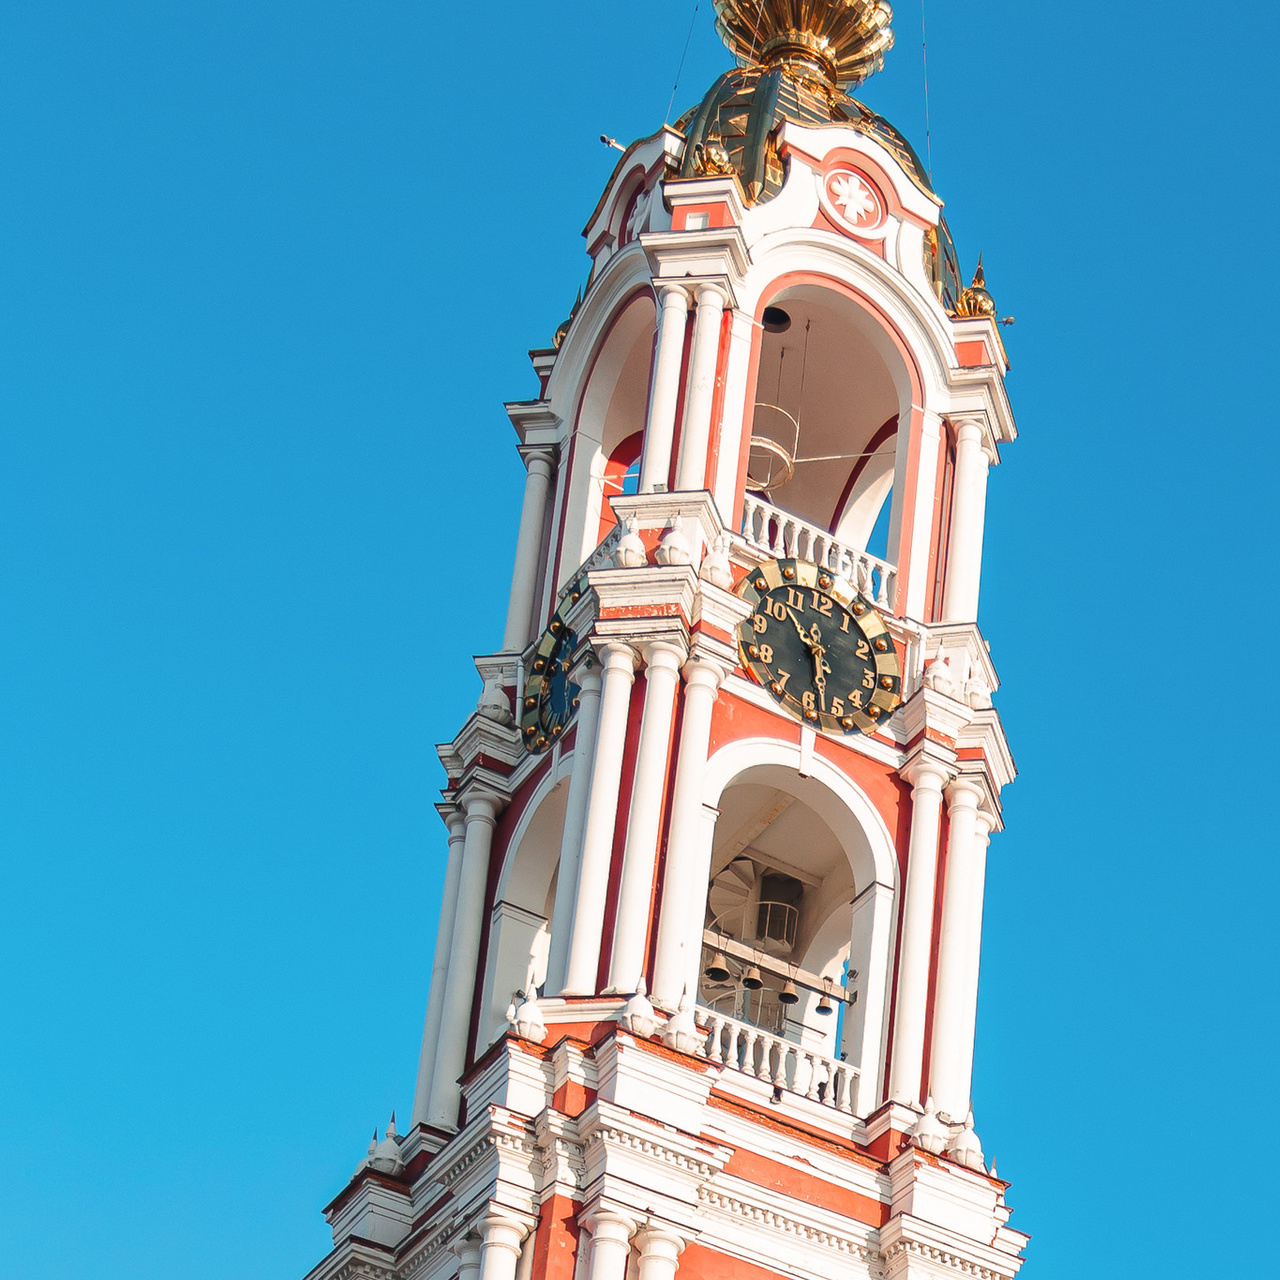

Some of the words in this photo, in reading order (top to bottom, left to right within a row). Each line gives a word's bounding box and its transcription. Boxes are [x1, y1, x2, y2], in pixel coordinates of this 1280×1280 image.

[764, 596, 787, 622] 10
[786, 587, 804, 613] 11
[810, 590, 834, 617] 12
[753, 614, 768, 634] 9
[840, 612, 850, 634] 1
[760, 644, 774, 664] 8
[856, 639, 870, 661] 2
[777, 668, 791, 688] 7
[862, 668, 875, 689] 3
[802, 691, 815, 710] 6
[831, 696, 844, 717] 5
[848, 689, 863, 708] 4
